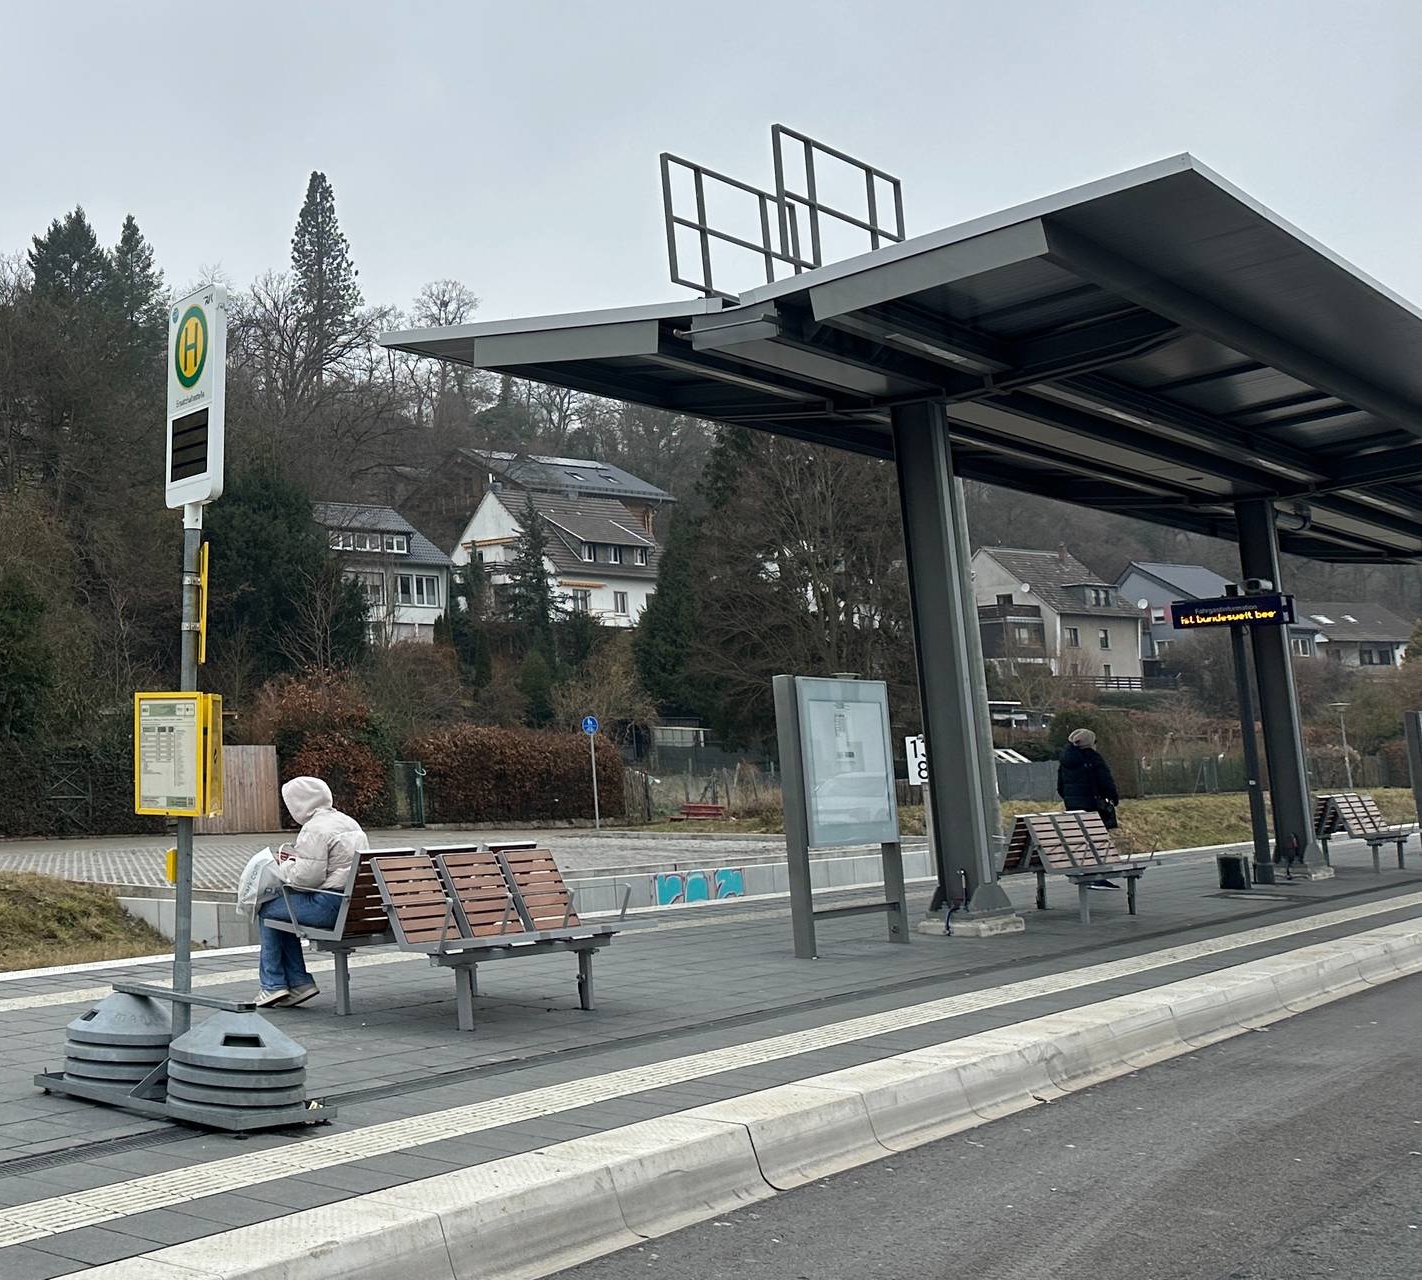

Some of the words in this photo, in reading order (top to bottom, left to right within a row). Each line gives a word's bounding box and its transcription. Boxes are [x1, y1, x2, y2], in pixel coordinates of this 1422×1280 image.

[184, 322, 198, 372] H
[1180, 616, 1195, 625] ist
[918, 760, 928, 779] 8
